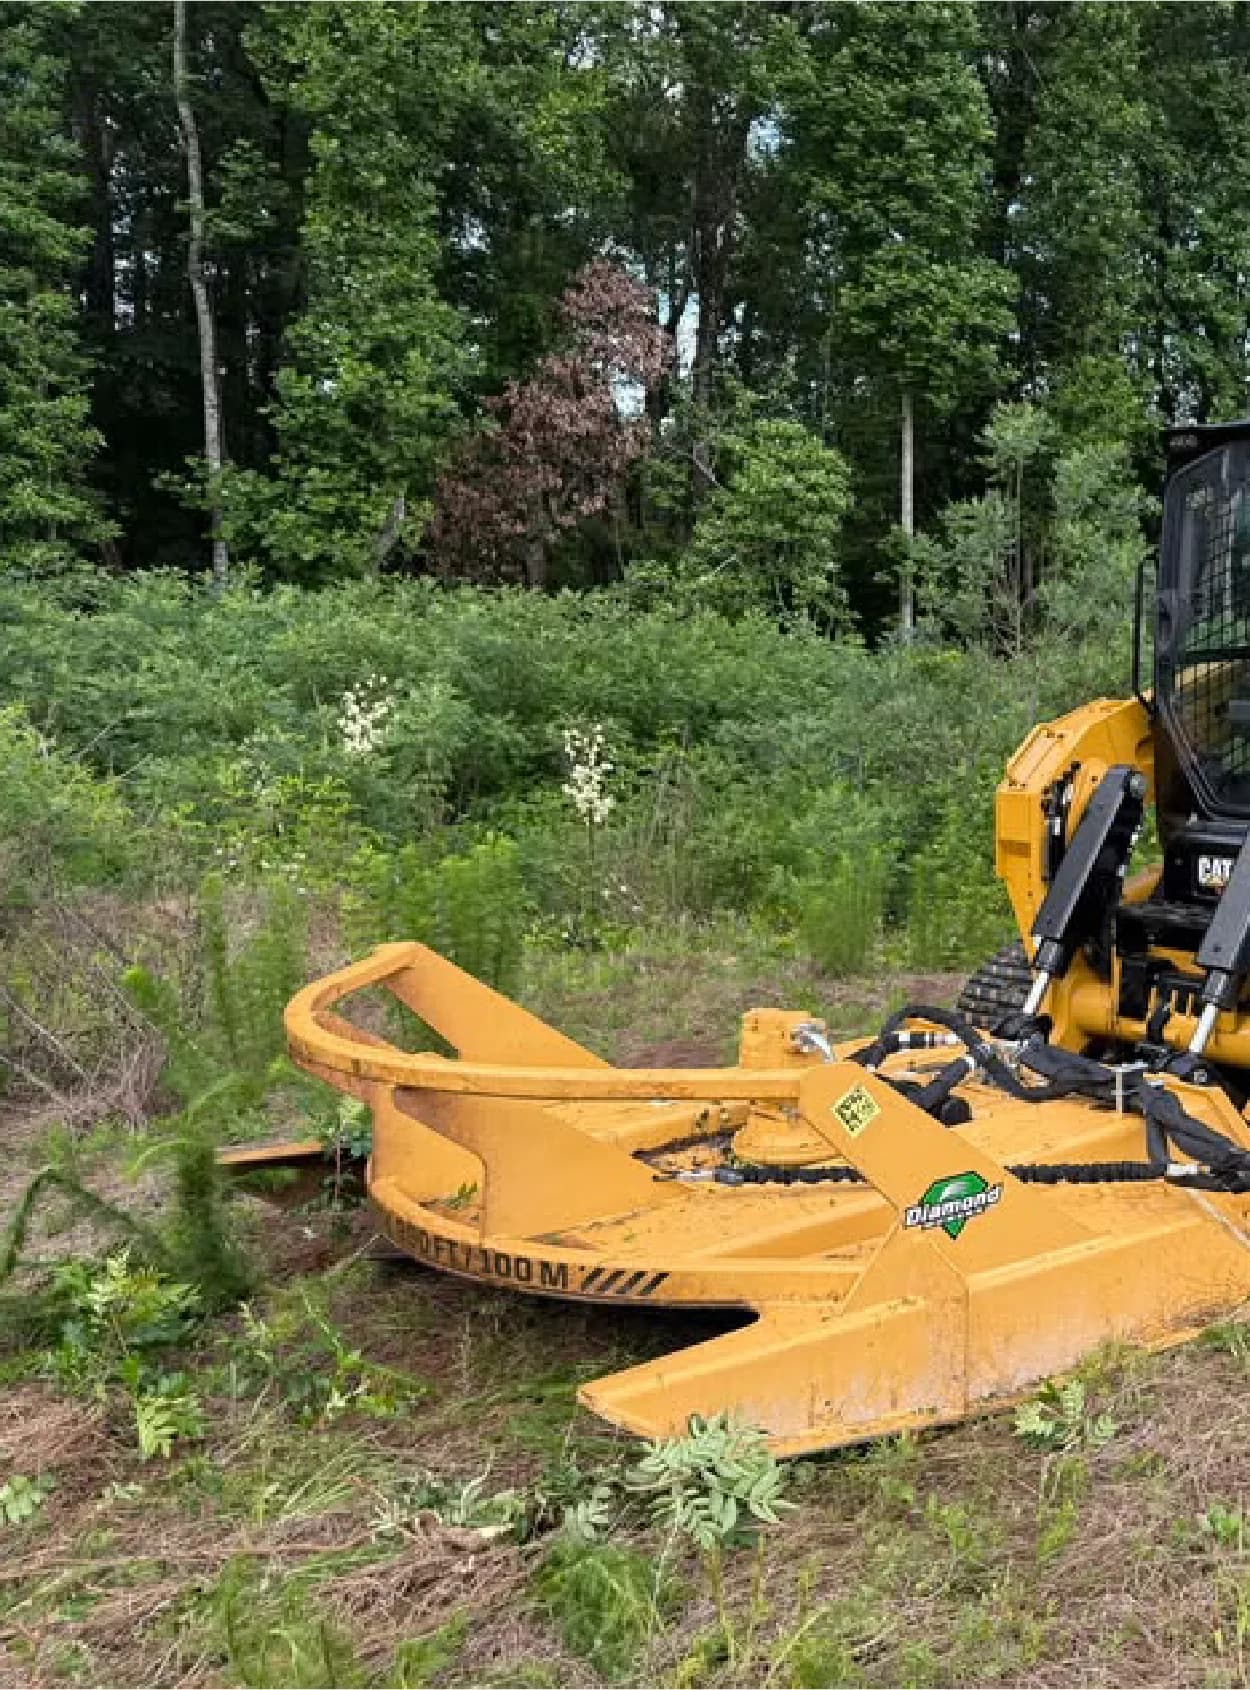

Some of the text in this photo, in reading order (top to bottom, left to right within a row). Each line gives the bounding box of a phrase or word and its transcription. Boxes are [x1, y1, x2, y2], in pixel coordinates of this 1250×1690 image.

[1198, 855, 1232, 885] CAT
[904, 1184, 1002, 1228] Diamond
[479, 1248, 531, 1282] 100
[540, 1260, 569, 1290] M
